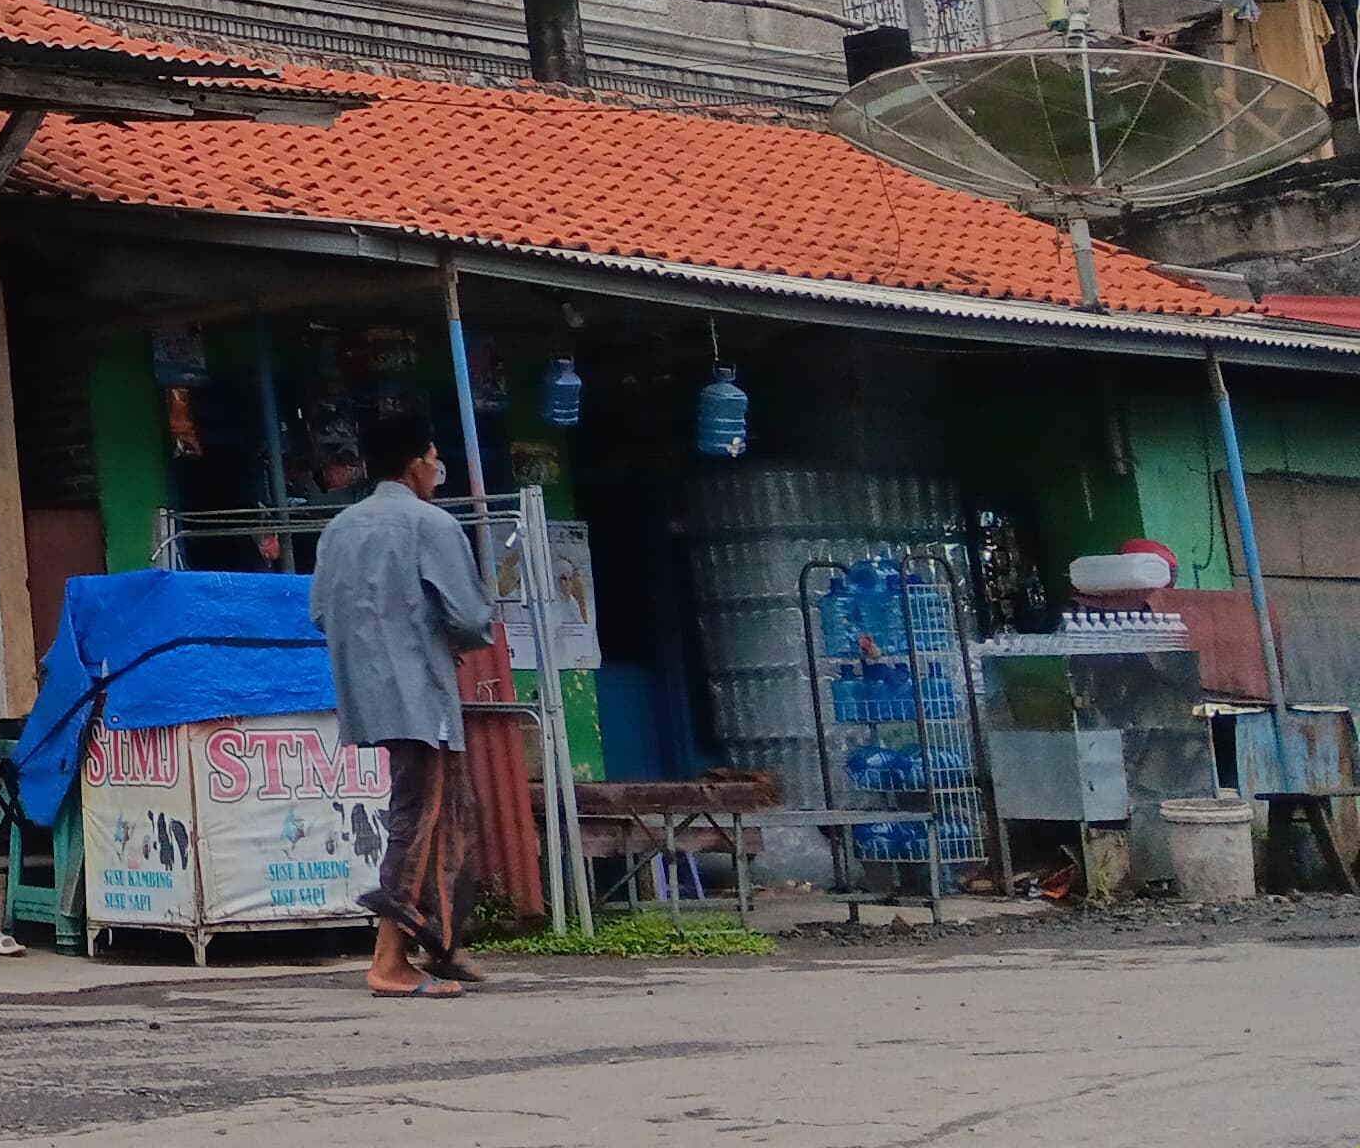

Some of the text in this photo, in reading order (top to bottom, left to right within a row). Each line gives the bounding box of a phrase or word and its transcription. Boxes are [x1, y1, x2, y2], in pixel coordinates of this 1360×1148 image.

[86, 718, 179, 787] STMJ
[206, 728, 392, 802] STMJ
[104, 869, 173, 889] SUSU KAMBING
[269, 859, 351, 882] SUSU KAMBING
[104, 892, 152, 911] SUSU SAPI
[270, 884, 327, 907] SUSU SAPI
